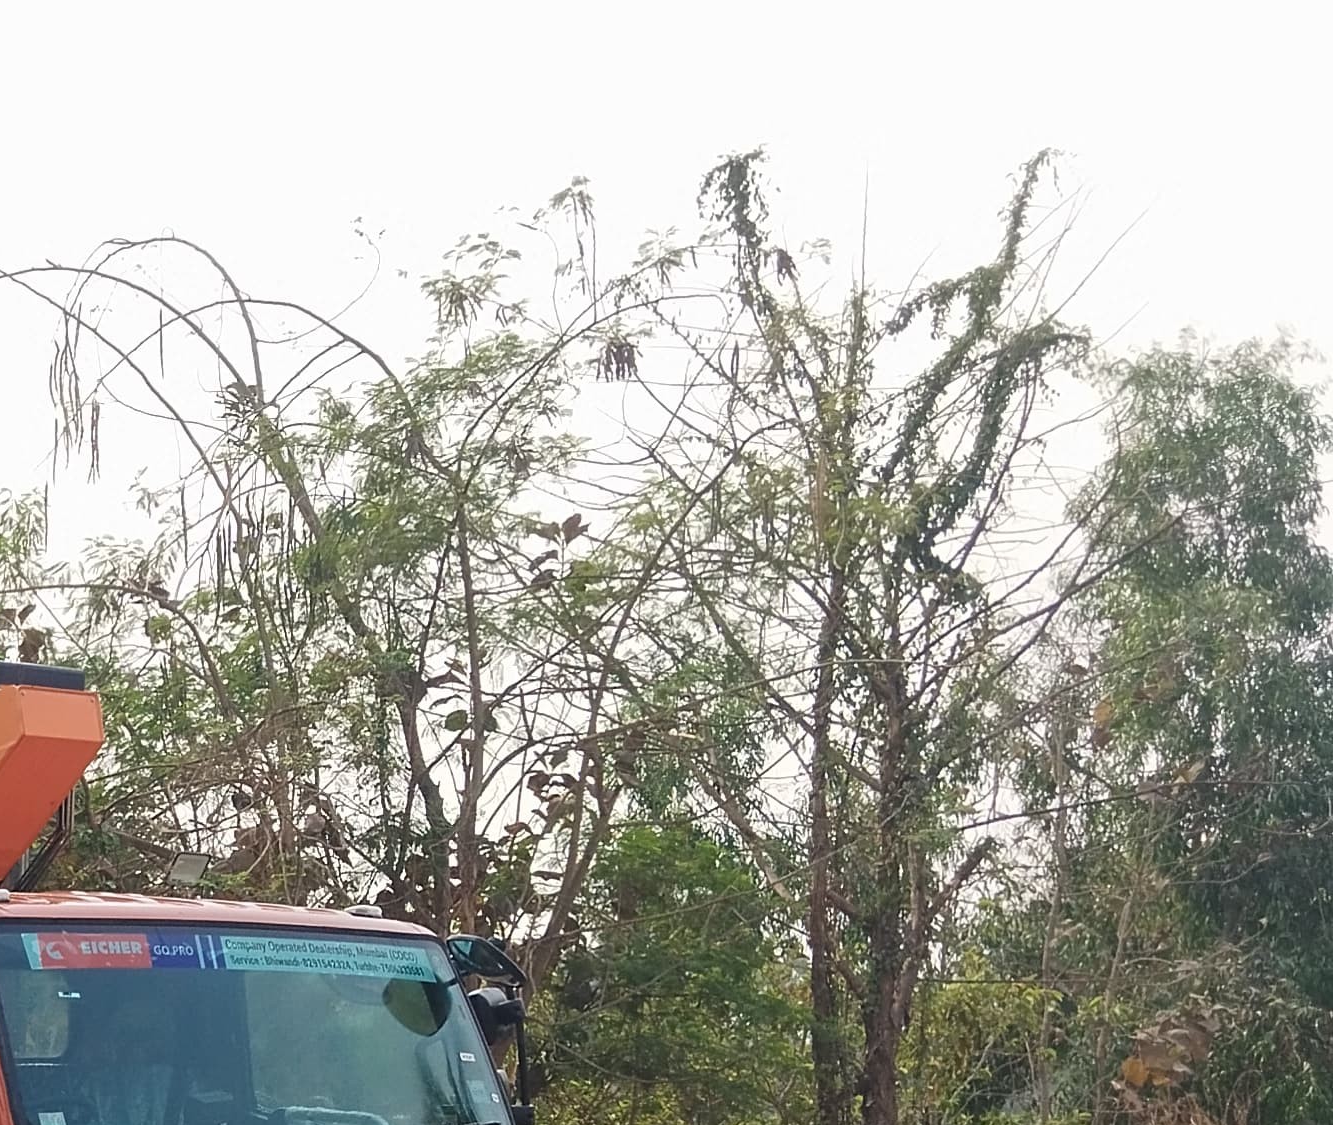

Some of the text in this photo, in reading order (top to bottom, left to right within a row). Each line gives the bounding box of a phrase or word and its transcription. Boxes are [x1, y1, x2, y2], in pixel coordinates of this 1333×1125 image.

[80, 941, 143, 955] EICHER
[225, 939, 266, 953] Company
[268, 941, 308, 954] Operated
